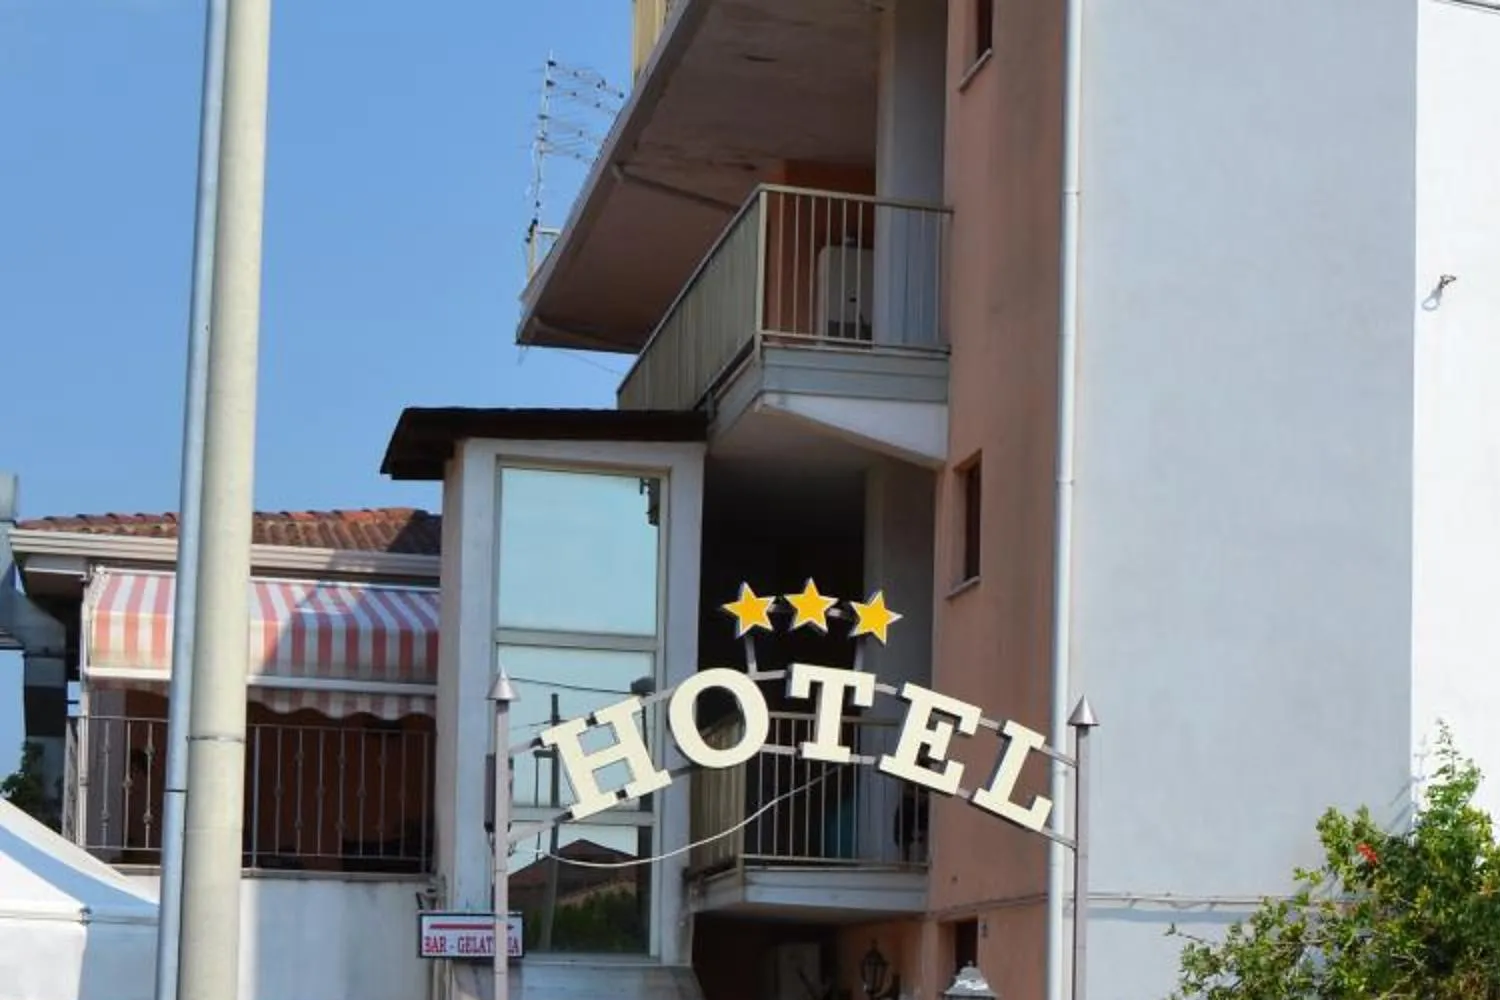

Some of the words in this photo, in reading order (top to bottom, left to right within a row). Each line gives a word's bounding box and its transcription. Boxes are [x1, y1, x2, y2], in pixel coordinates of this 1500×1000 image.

[541, 663, 1053, 832] HOTEL
[424, 936, 448, 953] BAR
[457, 936, 520, 953] GELATIA
